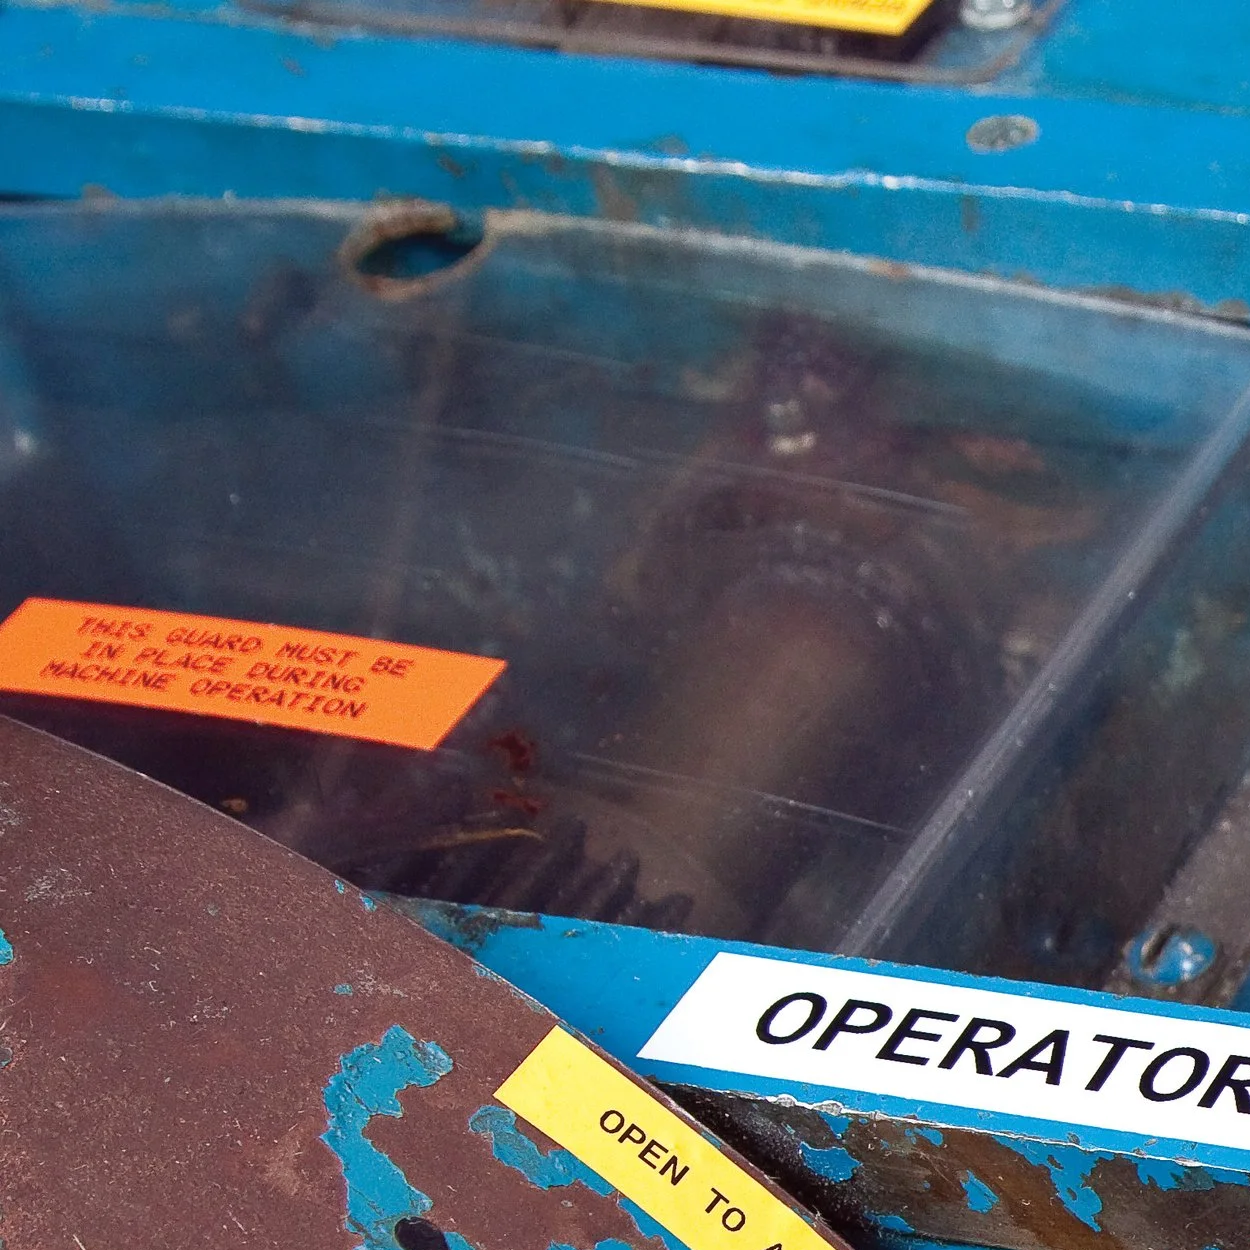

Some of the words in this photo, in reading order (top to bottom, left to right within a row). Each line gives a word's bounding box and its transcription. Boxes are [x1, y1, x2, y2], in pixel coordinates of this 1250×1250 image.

[77, 616, 152, 641] THIS
[166, 627, 263, 652] GUARD
[275, 641, 358, 667] MUST
[371, 656, 414, 678] BE
[81, 641, 125, 661] IN
[134, 647, 233, 674] PLACE
[247, 662, 366, 694] DURING
[41, 659, 175, 690] MACHINE
[191, 677, 369, 718] OPERATION
[599, 1109, 690, 1186] OPEN
[704, 1187, 746, 1232] TO
